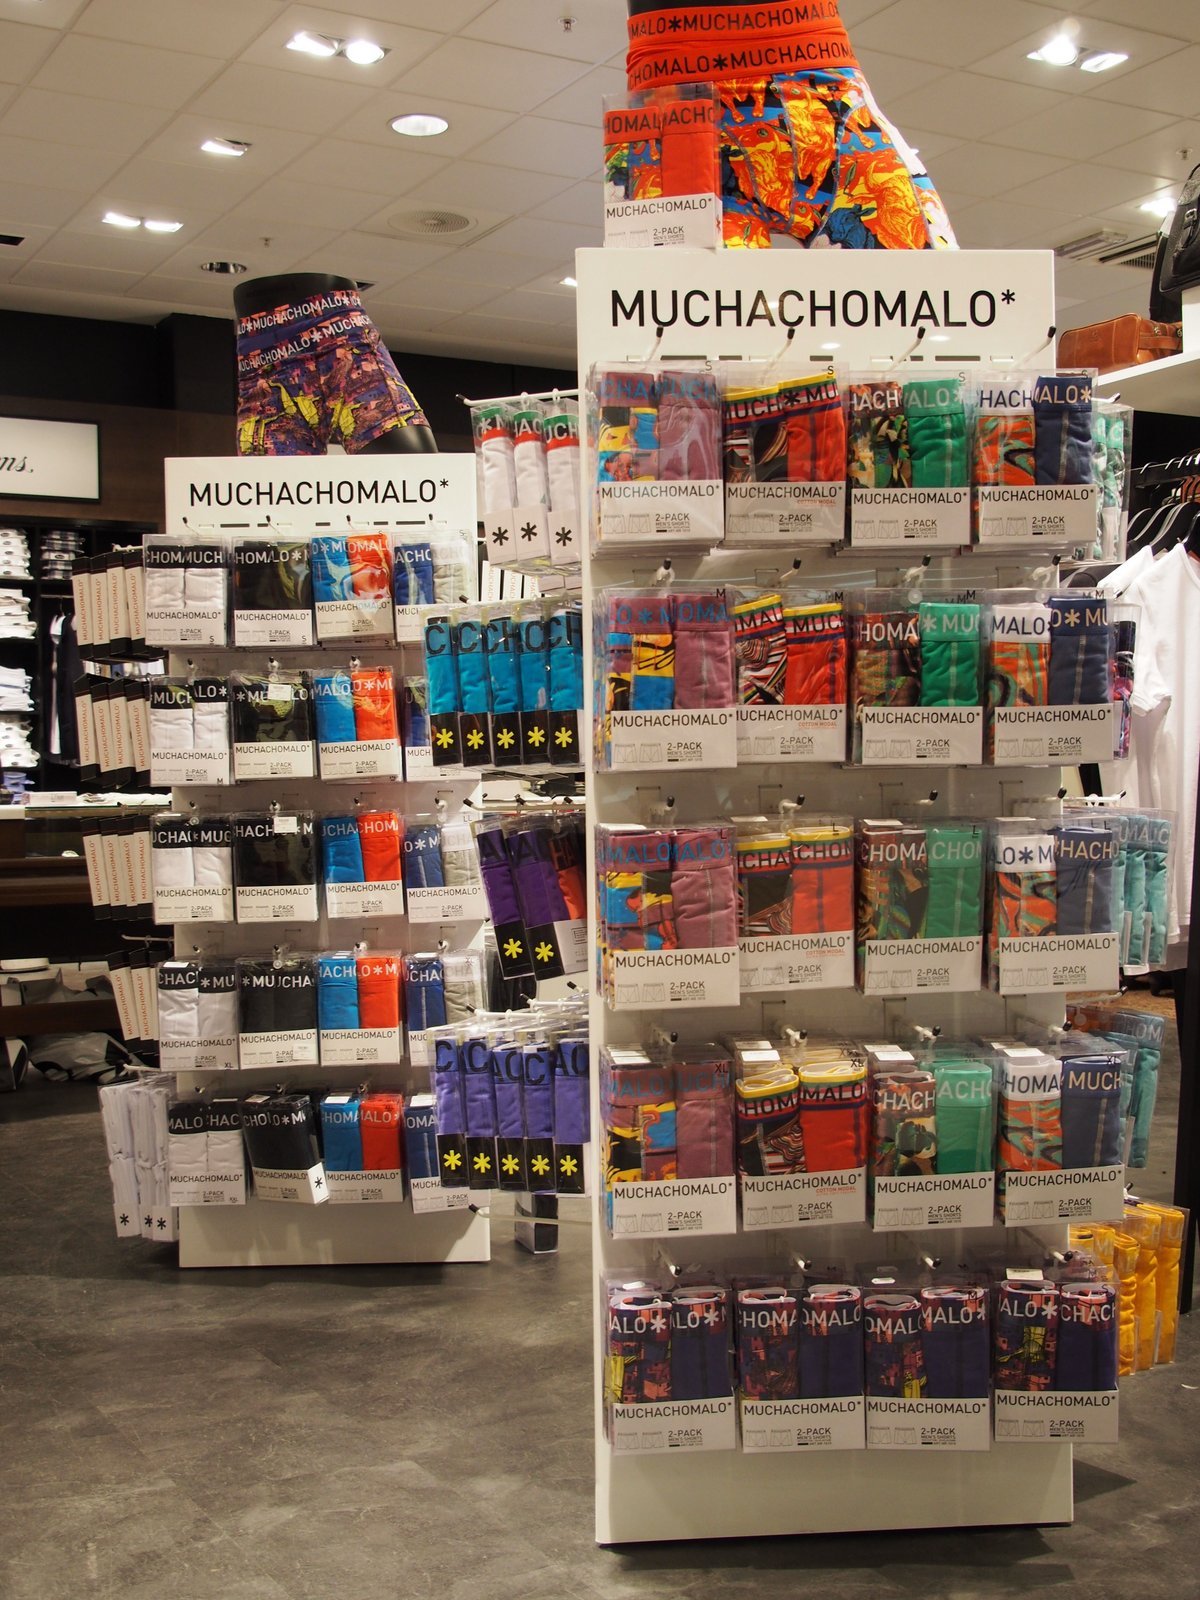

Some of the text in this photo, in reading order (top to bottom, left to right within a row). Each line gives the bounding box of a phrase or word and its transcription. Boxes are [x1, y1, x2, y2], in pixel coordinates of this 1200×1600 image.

[653, 226, 684, 237] 2-PACK
[827, 366, 835, 376] S
[655, 513, 690, 522] 2-PACK
[779, 514, 812, 522] 2-PACK
[1032, 516, 1065, 525] 2-PACK
[904, 519, 937, 528] 2-PACK
[716, 589, 726, 599] M
[834, 592, 844, 601] M
[966, 590, 976, 599] M
[1095, 590, 1105, 599] M
[780, 737, 814, 745] 2-PACK
[916, 739, 950, 748] 2-PACK
[1048, 737, 1082, 746] 2-PACK
[667, 742, 702, 751] 2-PACK
[788, 965, 822, 974] 2-PACK
[917, 968, 950, 977] 2-PACK
[1053, 965, 1087, 975] 2-PACK
[670, 981, 705, 990] 2-PACK
[798, 1202, 833, 1212] 2-PACK
[1059, 1198, 1092, 1207] 2-PACK
[928, 1205, 962, 1214] 2-PACK
[668, 1211, 702, 1220] 2-PACK
[1049, 1420, 1084, 1428] 2-PACK
[668, 1428, 703, 1438] 2-PACK
[797, 1427, 831, 1436] 2-PACK
[921, 1427, 956, 1435] 2-PACK
